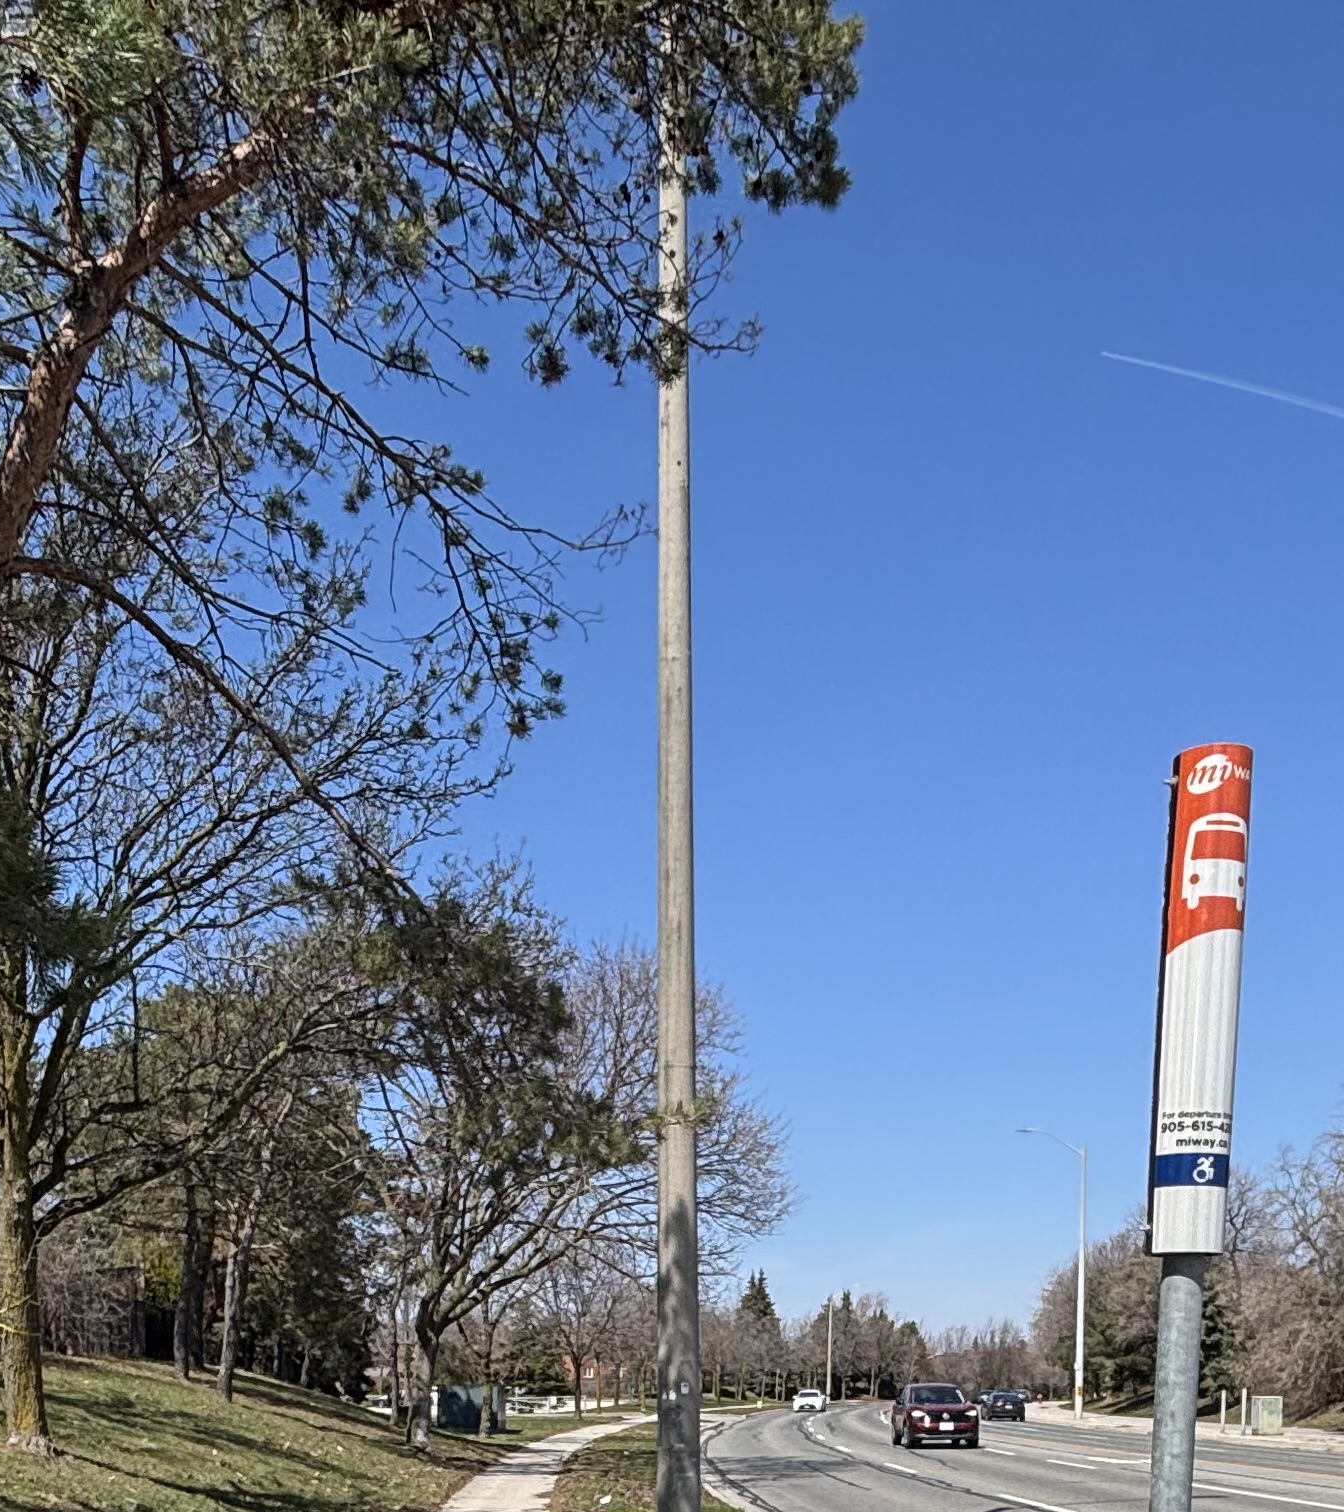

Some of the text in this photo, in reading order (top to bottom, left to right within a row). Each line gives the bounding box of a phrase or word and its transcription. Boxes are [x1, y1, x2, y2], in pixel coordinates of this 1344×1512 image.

[1162, 1112, 1176, 1120] For
[1177, 1110, 1222, 1119] departure
[1161, 1120, 1231, 1133] 905-615-42
[1176, 1137, 1228, 1149] miway.ca
